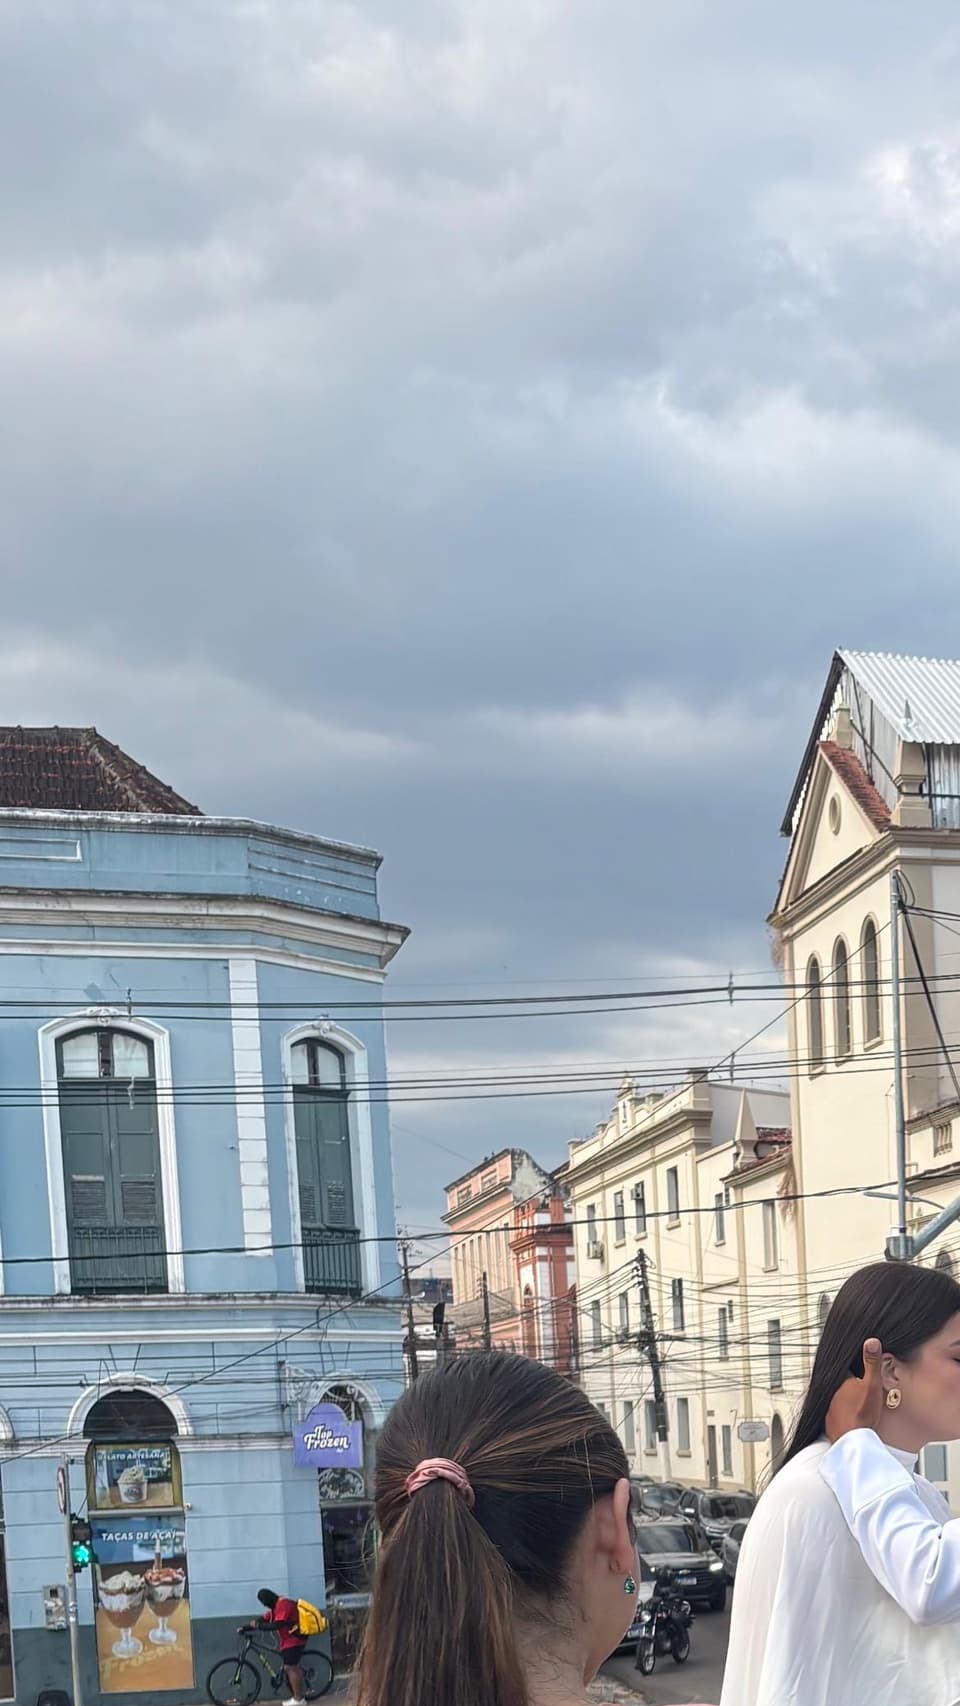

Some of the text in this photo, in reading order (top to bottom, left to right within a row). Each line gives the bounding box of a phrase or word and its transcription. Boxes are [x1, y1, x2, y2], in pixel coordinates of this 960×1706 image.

[314, 1424, 333, 1440] Top
[303, 1432, 349, 1451] Frozen
[101, 1531, 134, 1544] TAÇAS
[136, 1530, 150, 1541] DE
